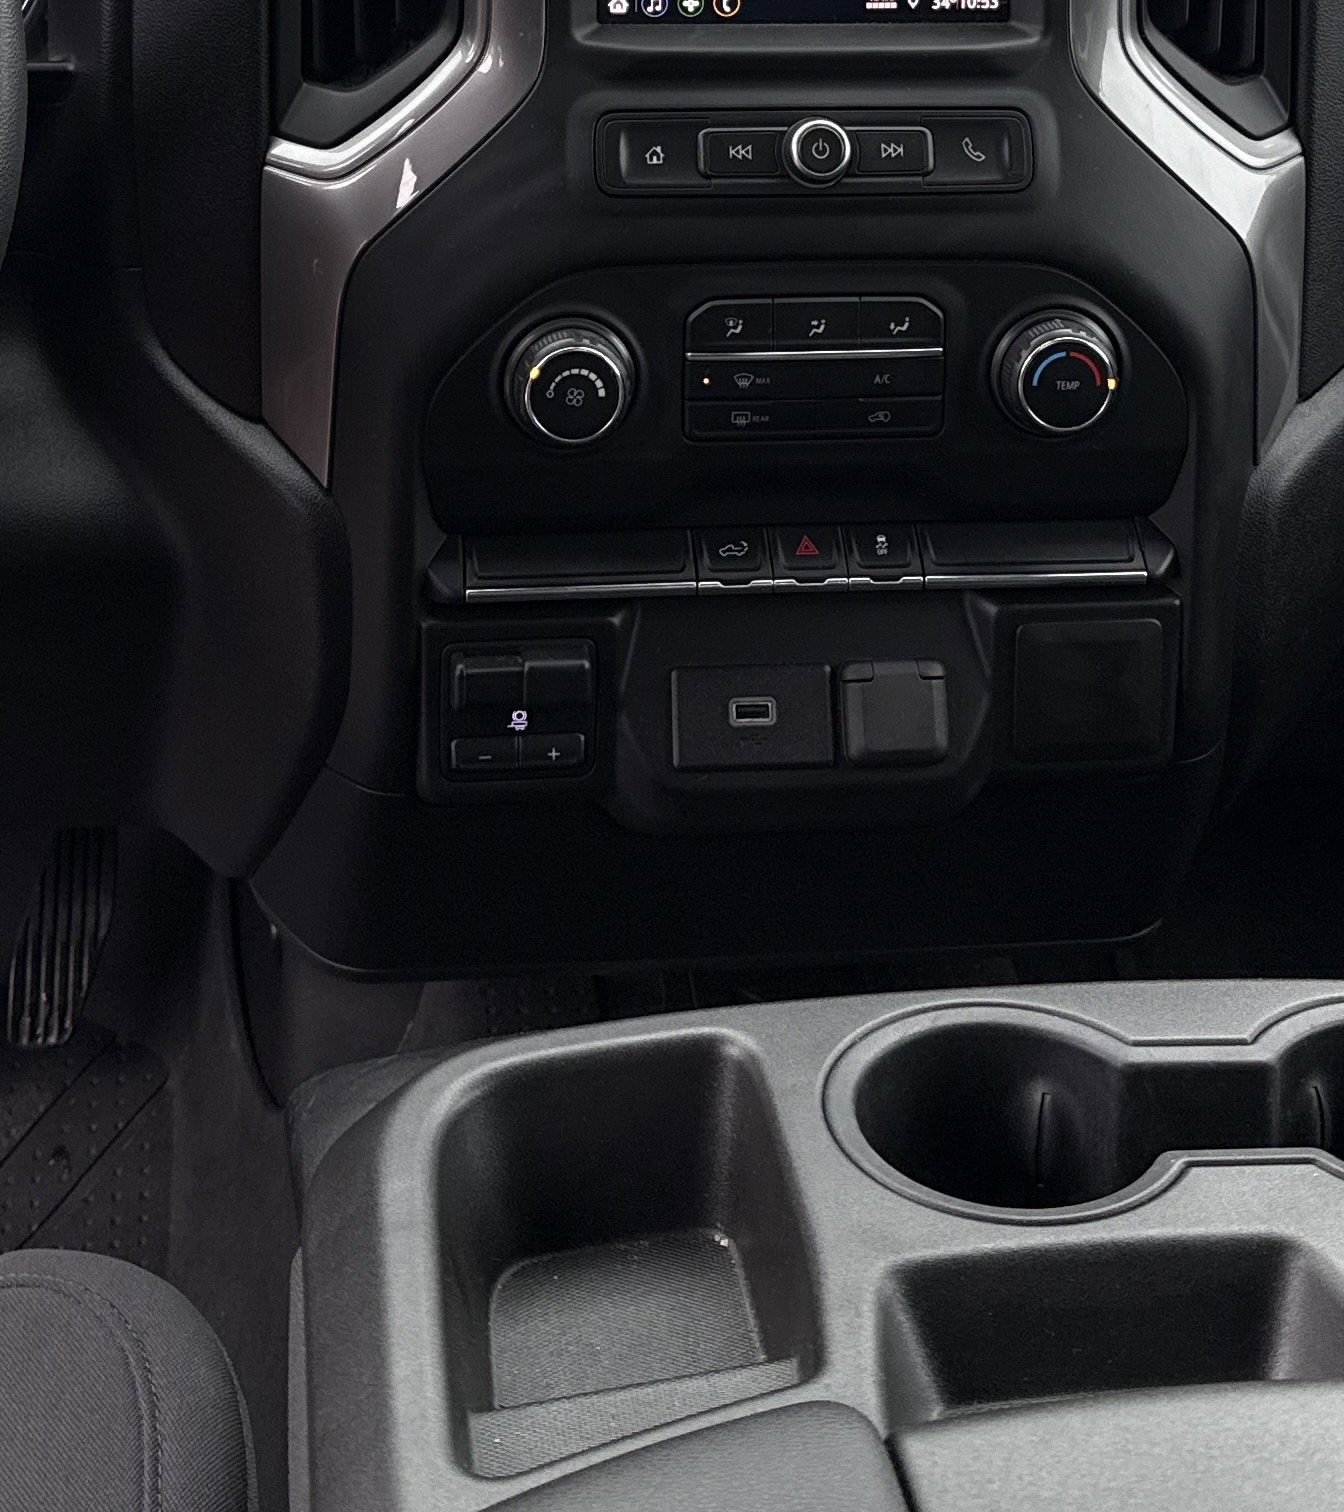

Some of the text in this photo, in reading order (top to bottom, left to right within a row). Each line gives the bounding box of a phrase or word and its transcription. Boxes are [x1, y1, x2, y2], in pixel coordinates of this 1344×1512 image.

[755, 376, 771, 385] MAX
[873, 373, 891, 385] A/C
[1055, 380, 1081, 391] TEMP
[752, 414, 770, 423] REAR
